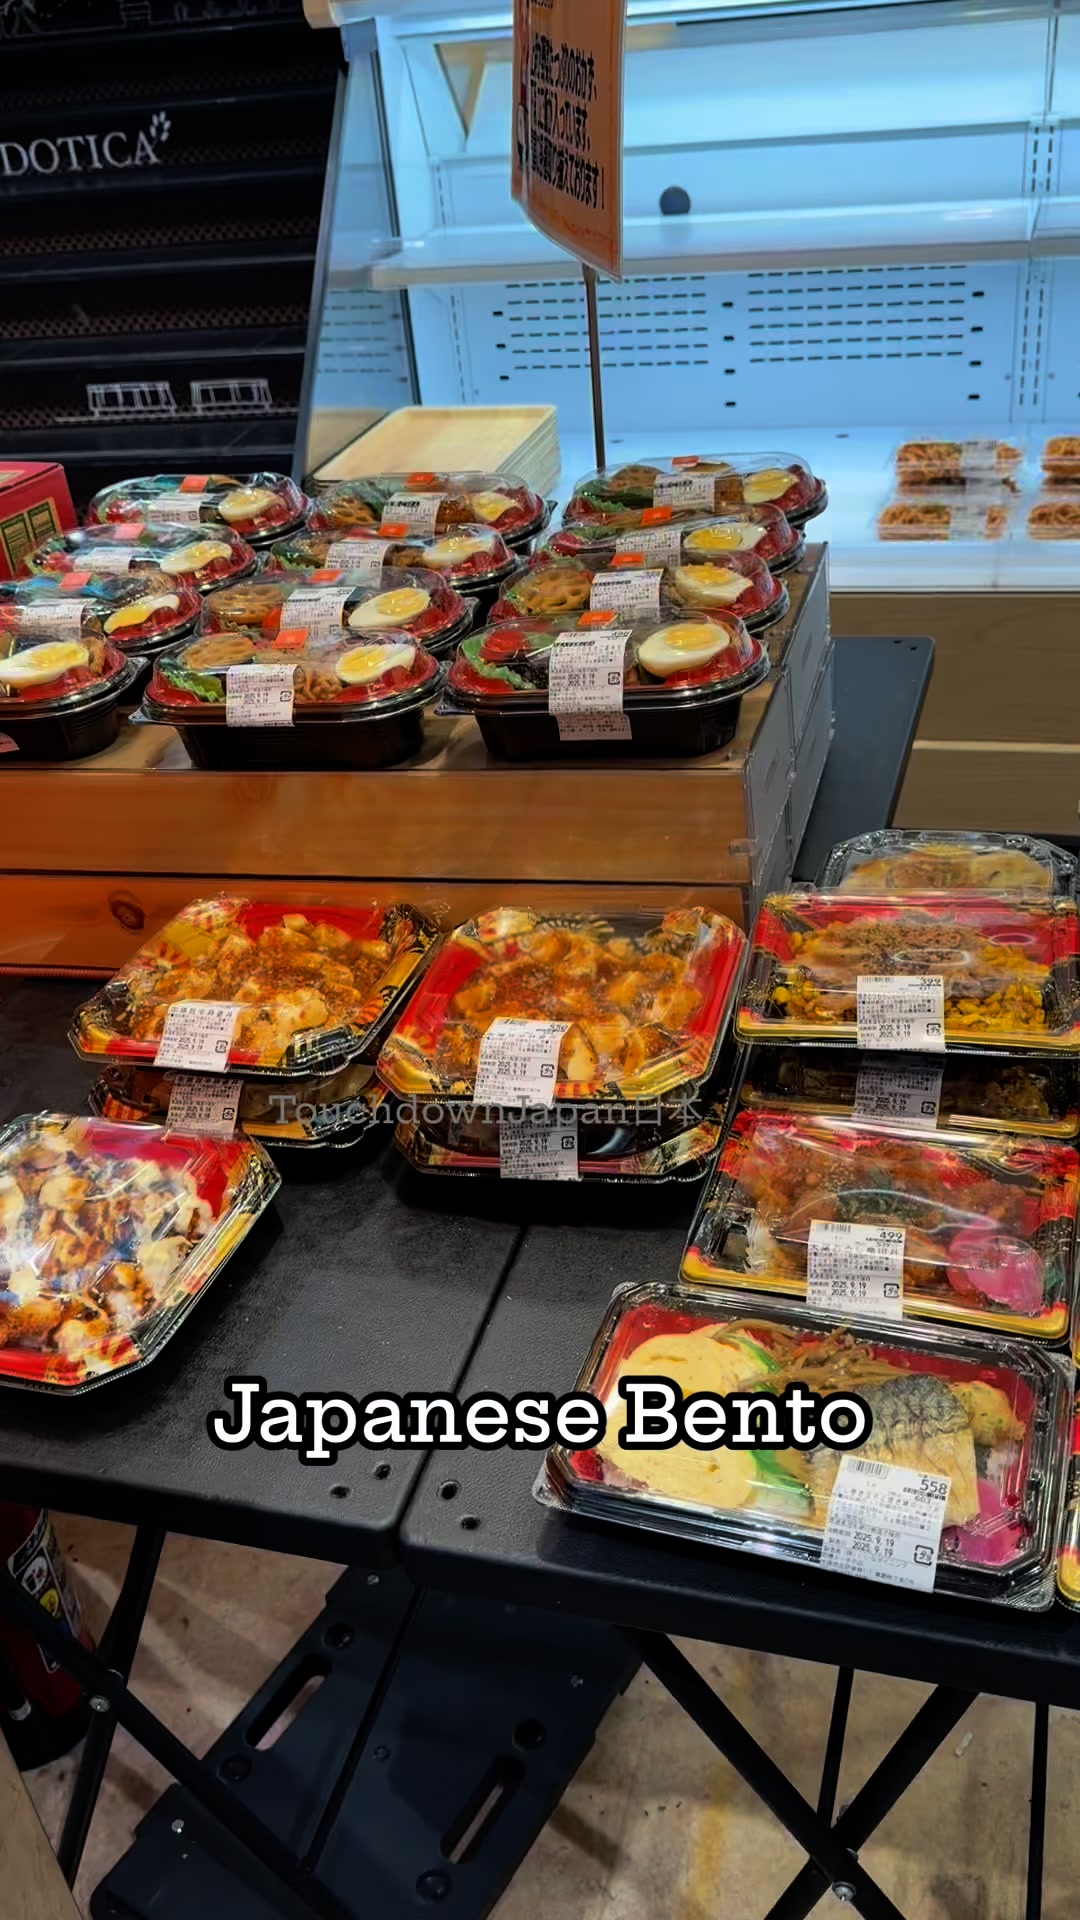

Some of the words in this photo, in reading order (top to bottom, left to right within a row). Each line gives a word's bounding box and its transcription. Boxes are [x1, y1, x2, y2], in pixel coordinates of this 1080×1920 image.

[0, 130, 162, 177] DOTICA
[879, 1231, 903, 1240] 499
[919, 1478, 948, 1496] 558
